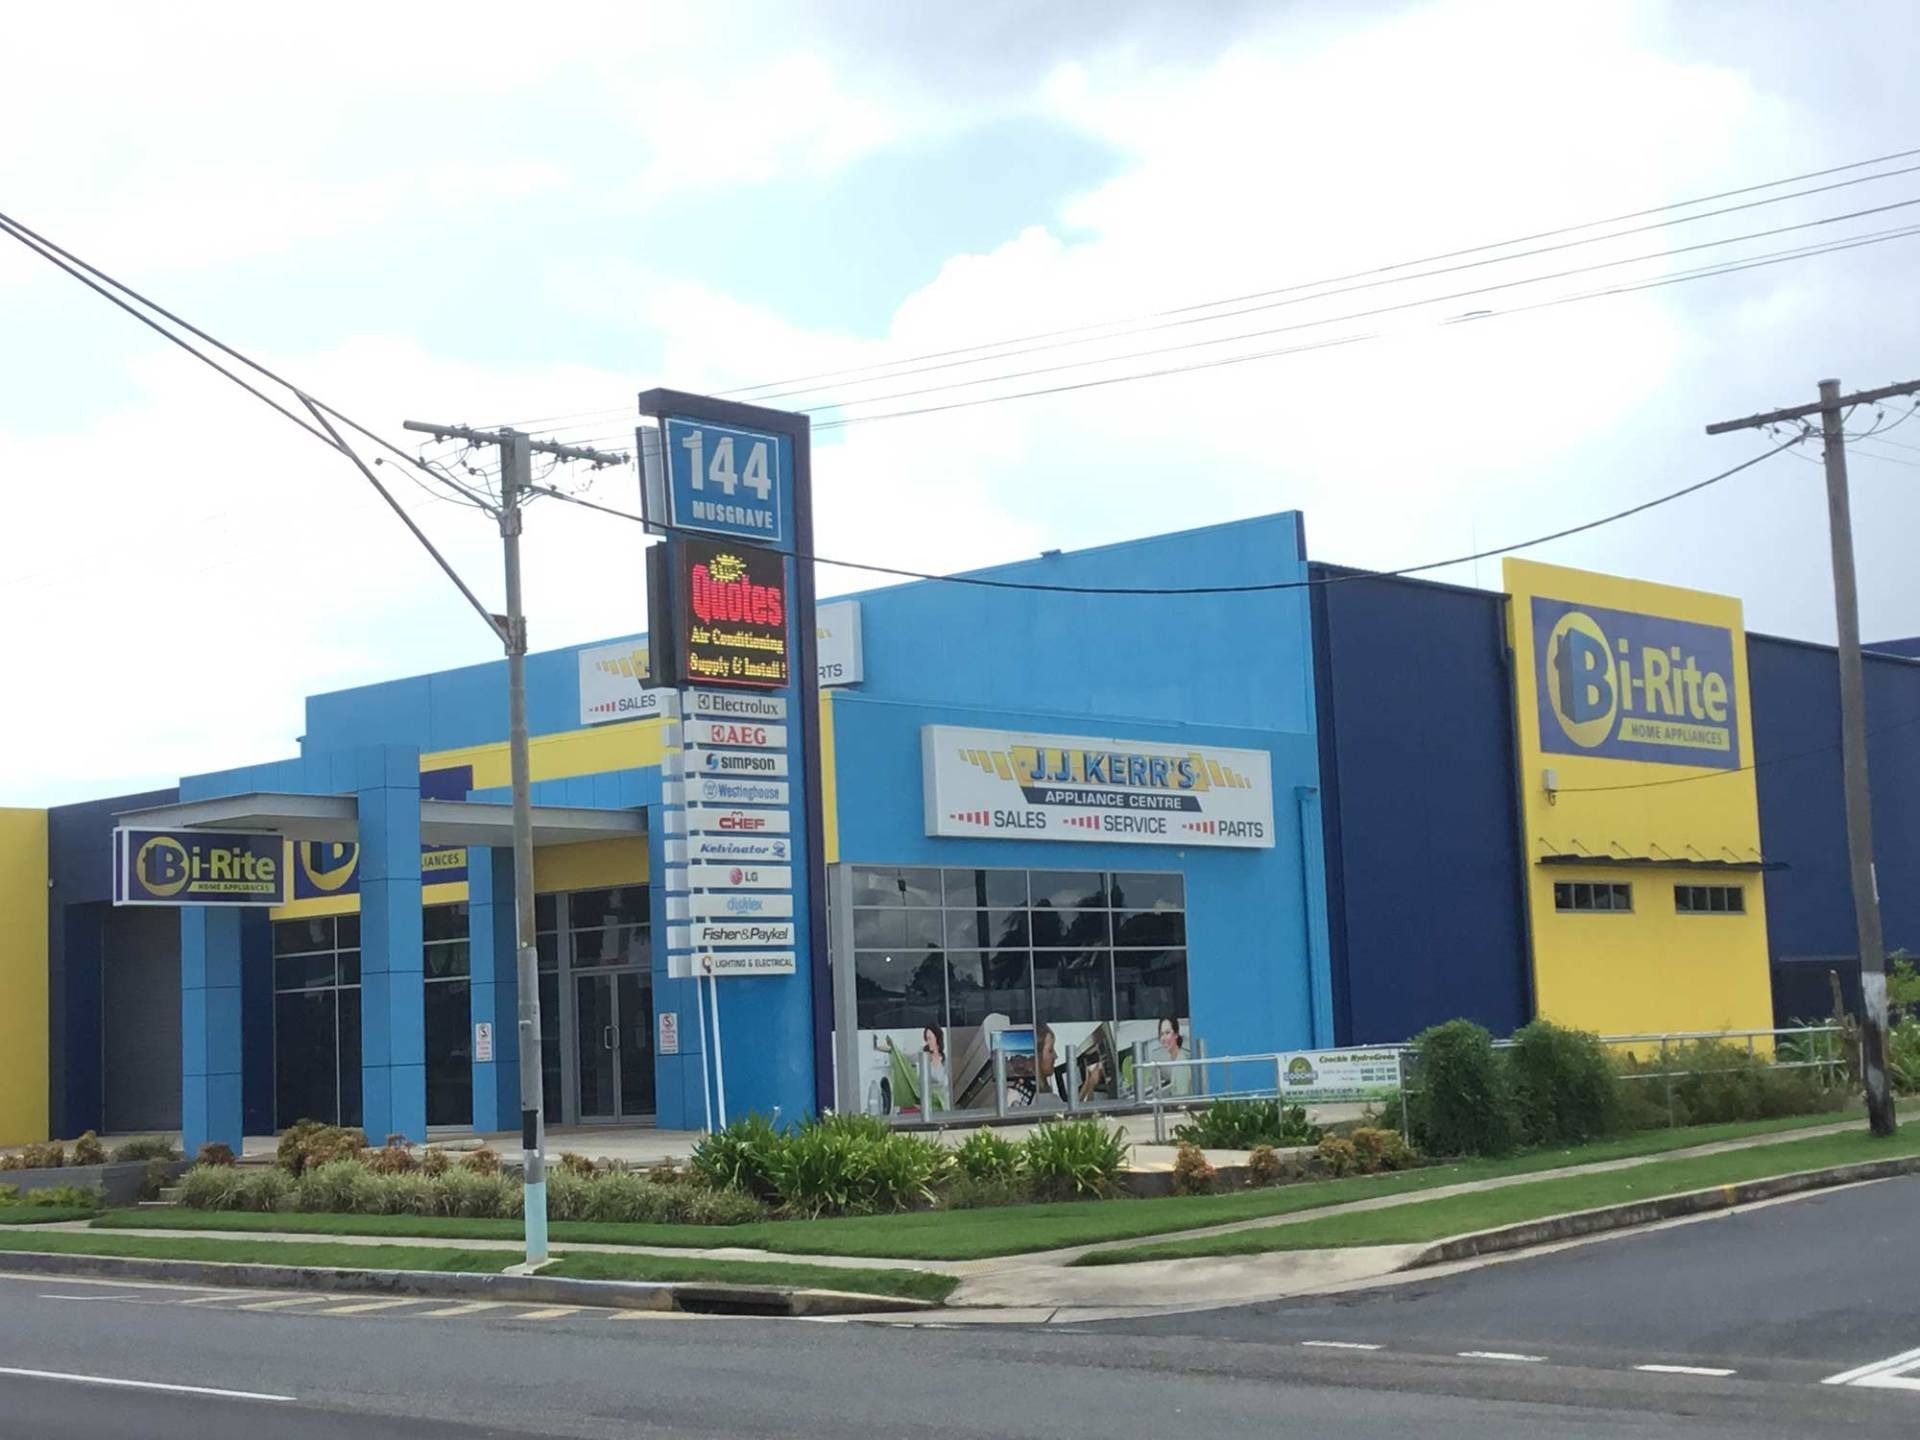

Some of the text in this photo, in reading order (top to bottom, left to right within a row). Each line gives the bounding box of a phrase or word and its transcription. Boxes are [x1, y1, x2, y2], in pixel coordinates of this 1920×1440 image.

[682, 430, 772, 500] 144
[692, 501, 773, 529] MUSGRAVE
[691, 563, 783, 625] Quotes
[691, 625, 784, 655] Air Conditioning
[690, 652, 730, 676] Supply
[818, 663, 843, 679] RTS
[1554, 627, 1728, 724] Bi-Rite
[618, 694, 656, 712] SALES
[713, 695, 779, 715] Electrolux
[726, 725, 767, 745] AEG
[1631, 723, 1723, 746] HOME APPLIANCES
[1082, 752, 1196, 789] KERR'S
[719, 783, 779, 801] Westinghouse
[1044, 790, 1182, 810] APPLIANCE CENTRE
[719, 816, 765, 830] CHEF
[994, 810, 1047, 830] SALES
[1104, 814, 1167, 835] SERVICE
[1218, 820, 1264, 839] PARTS
[700, 842, 769, 855] Kelvinator
[143, 843, 275, 886] Bi-Rite
[745, 871, 758, 882] LG
[198, 883, 270, 892] HOME APPLIANCES
[715, 960, 746, 969] LIGHTING
[754, 958, 793, 968] ELECTRICAL
